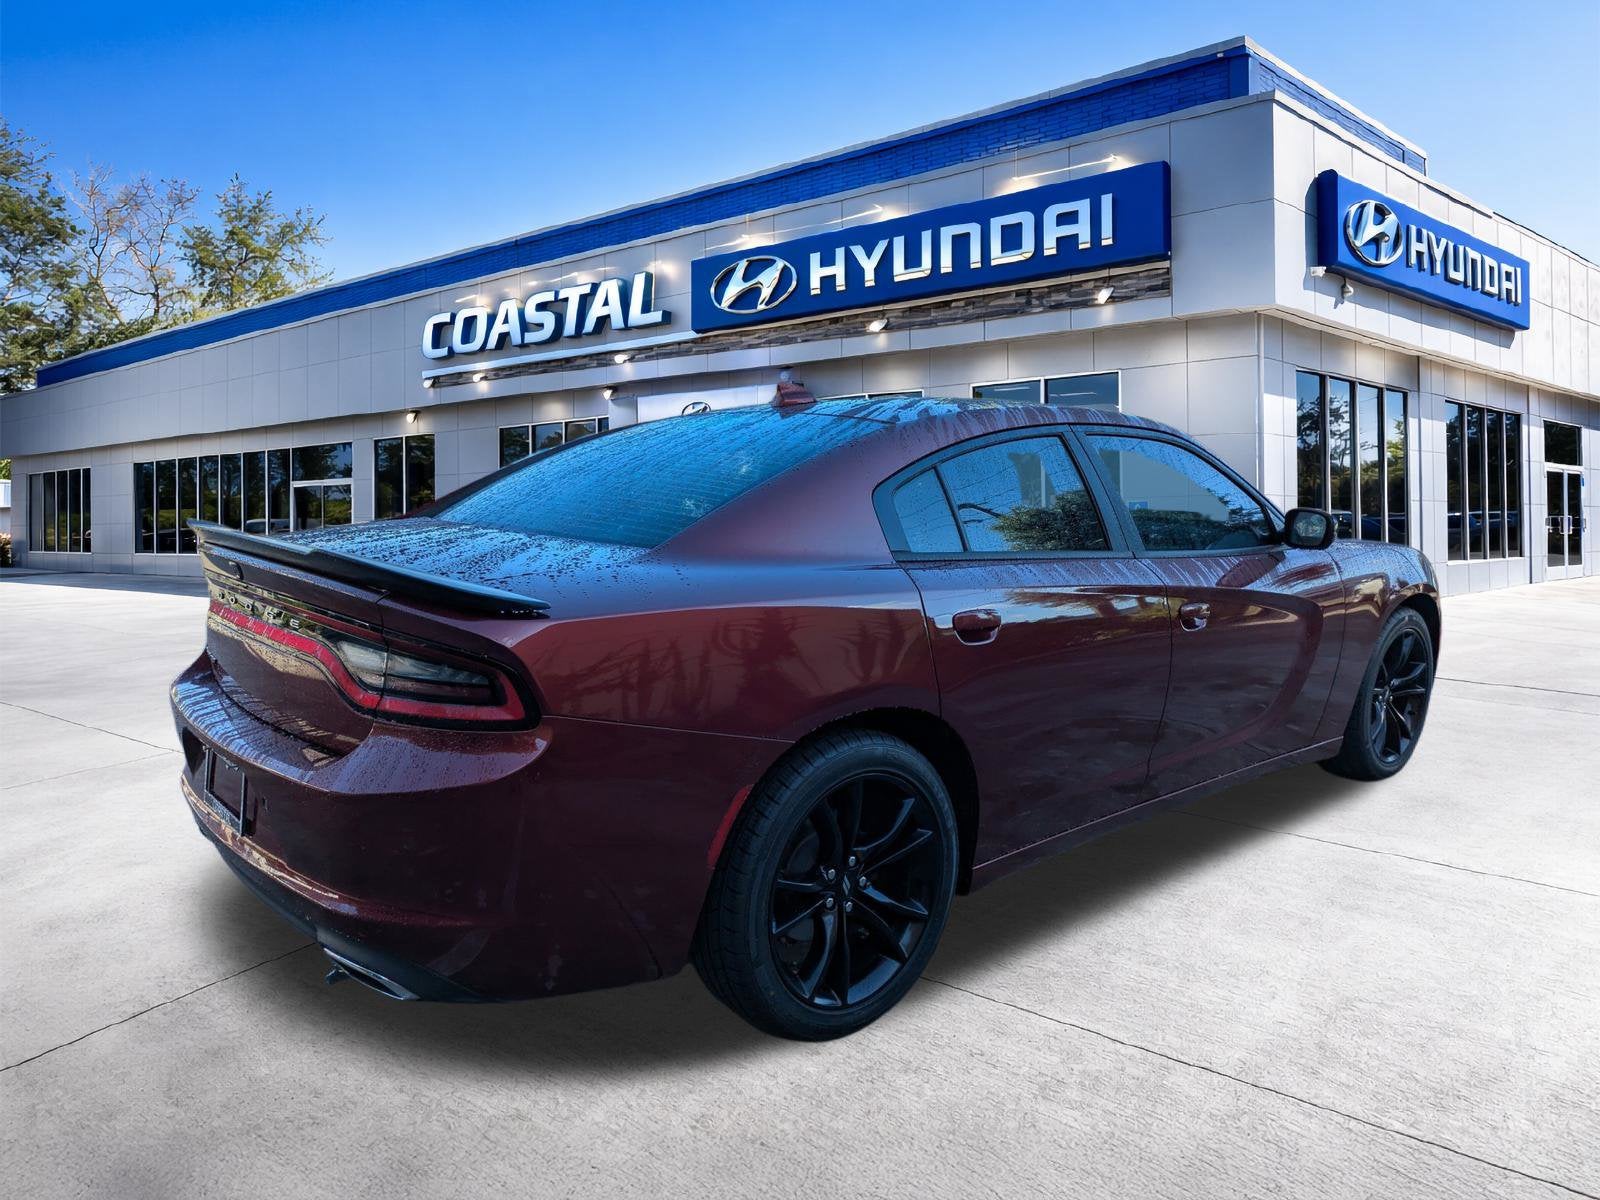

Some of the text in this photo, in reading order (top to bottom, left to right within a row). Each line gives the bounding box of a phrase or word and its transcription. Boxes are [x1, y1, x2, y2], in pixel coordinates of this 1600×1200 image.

[810, 193, 1113, 295] HYUNDAI
[1408, 224, 1522, 306] HYUNDAI
[422, 271, 668, 359] COASTAL
